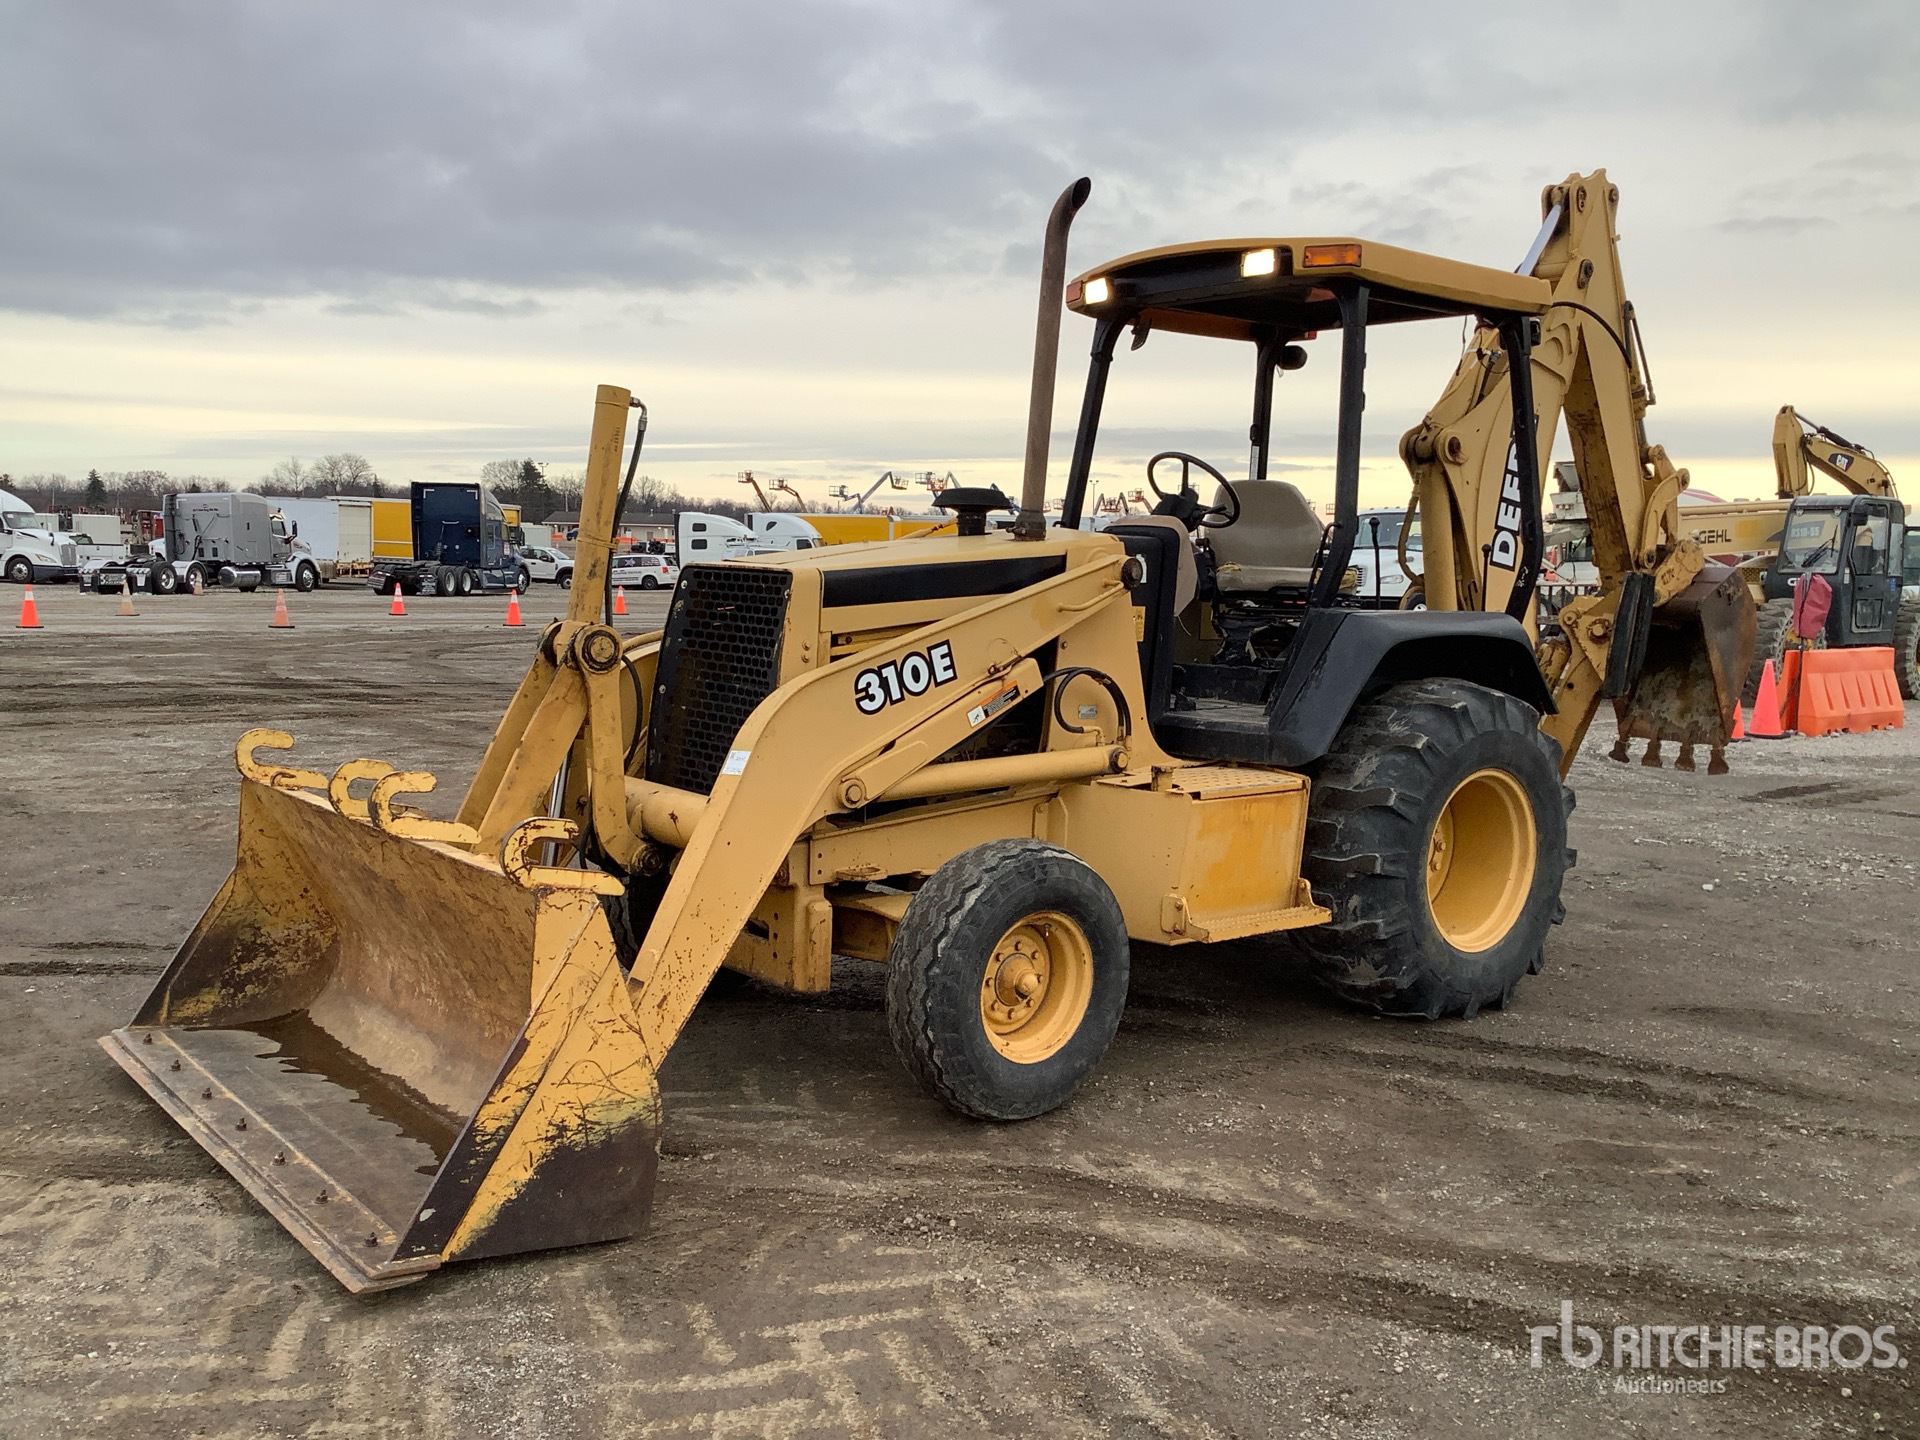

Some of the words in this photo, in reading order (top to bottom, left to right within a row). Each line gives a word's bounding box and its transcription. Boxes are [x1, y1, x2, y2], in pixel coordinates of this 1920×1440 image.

[1836, 454, 1849, 471] CAT
[1490, 420, 1533, 570] DEE
[1698, 529, 1732, 545] GEHL
[855, 640, 957, 714] 310E
